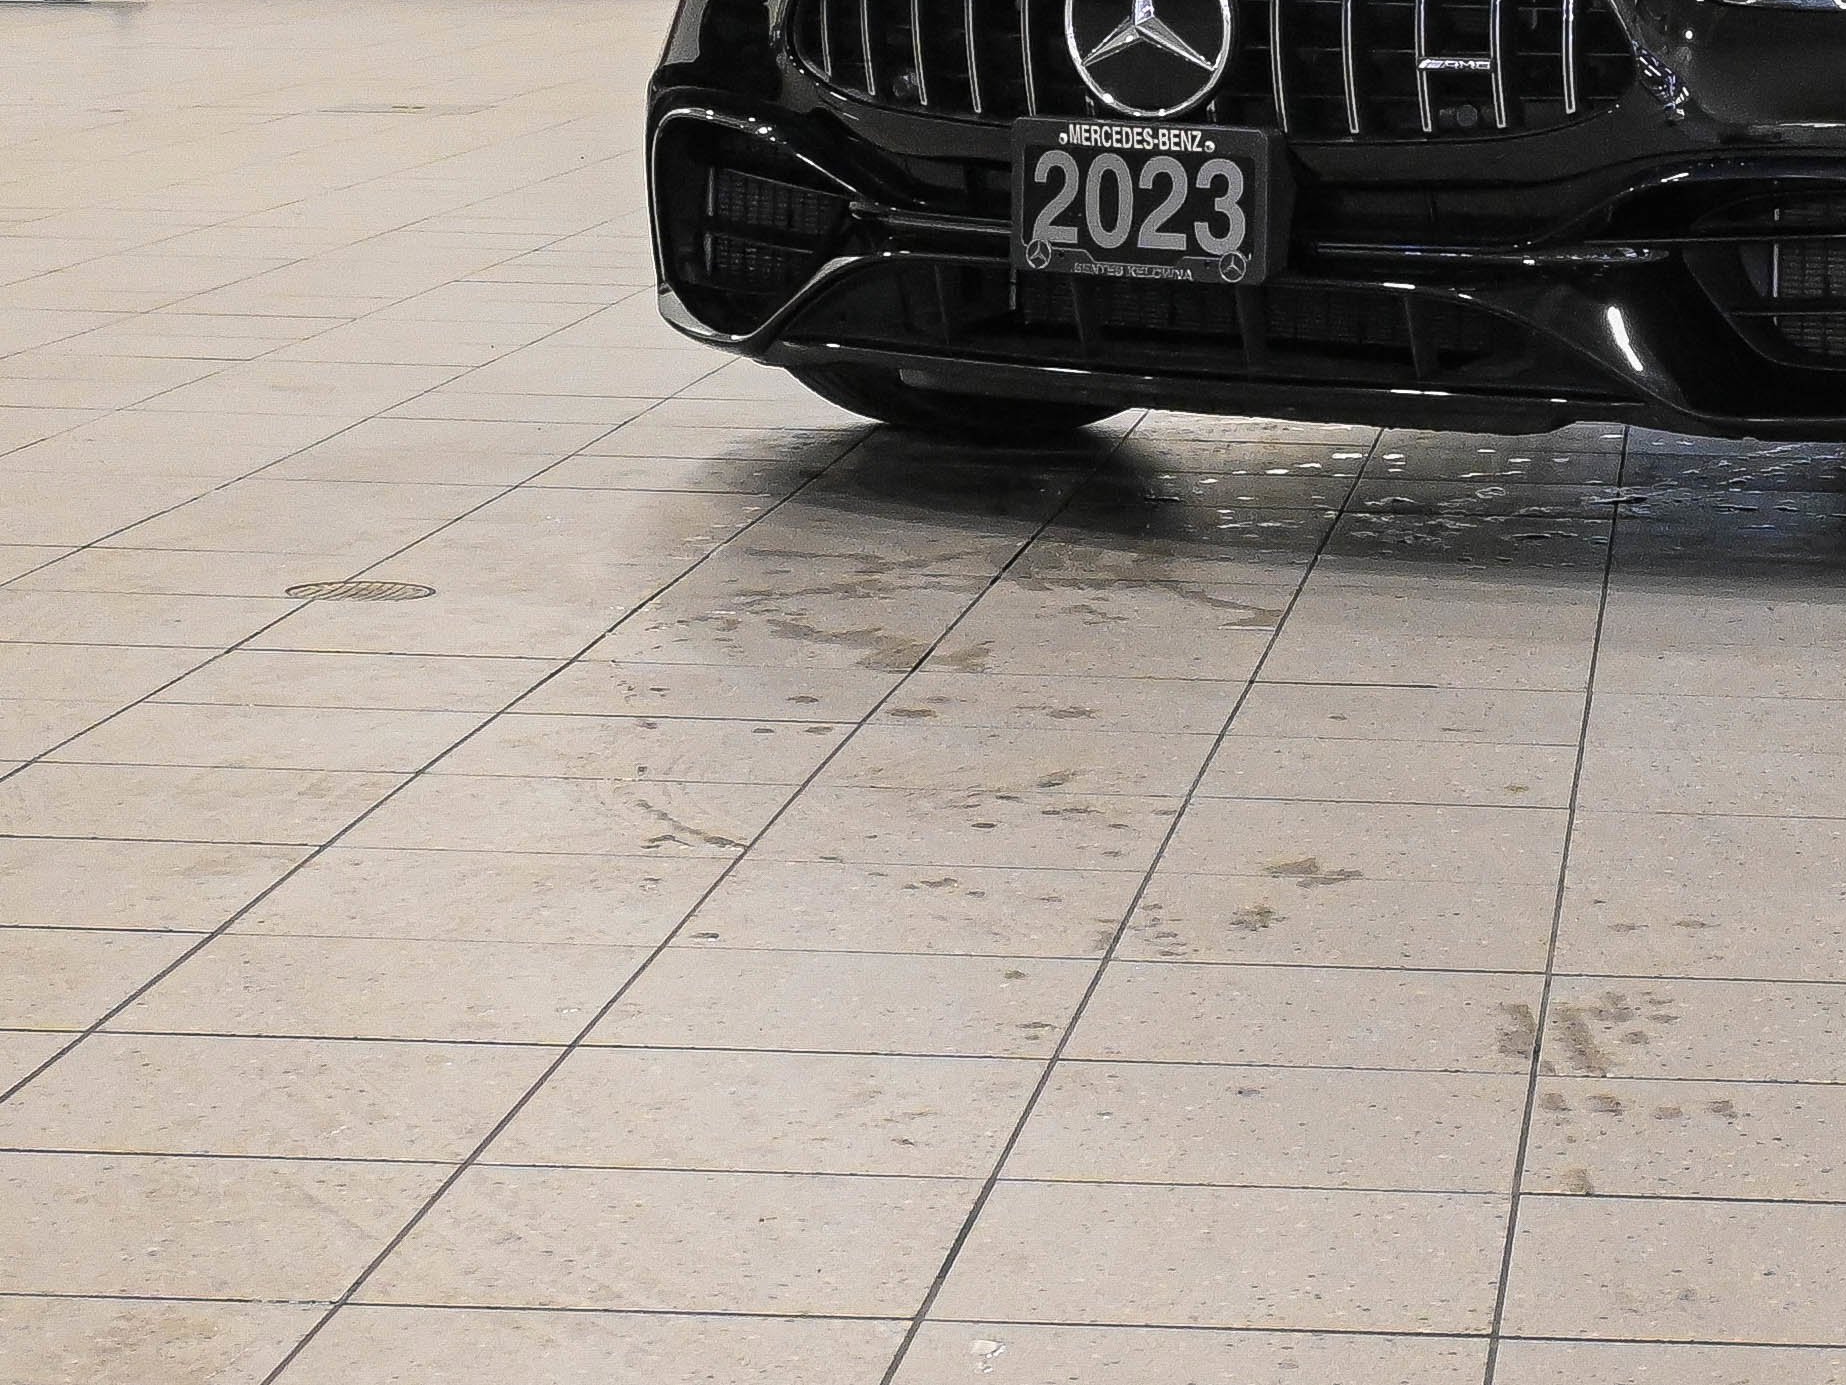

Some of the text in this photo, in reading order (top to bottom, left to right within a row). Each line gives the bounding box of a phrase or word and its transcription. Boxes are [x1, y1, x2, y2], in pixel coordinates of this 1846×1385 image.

[1442, 59, 1491, 70] AMG
[1068, 123, 1203, 153] MERCEDES-BENZ
[1031, 149, 1247, 256] 2023
